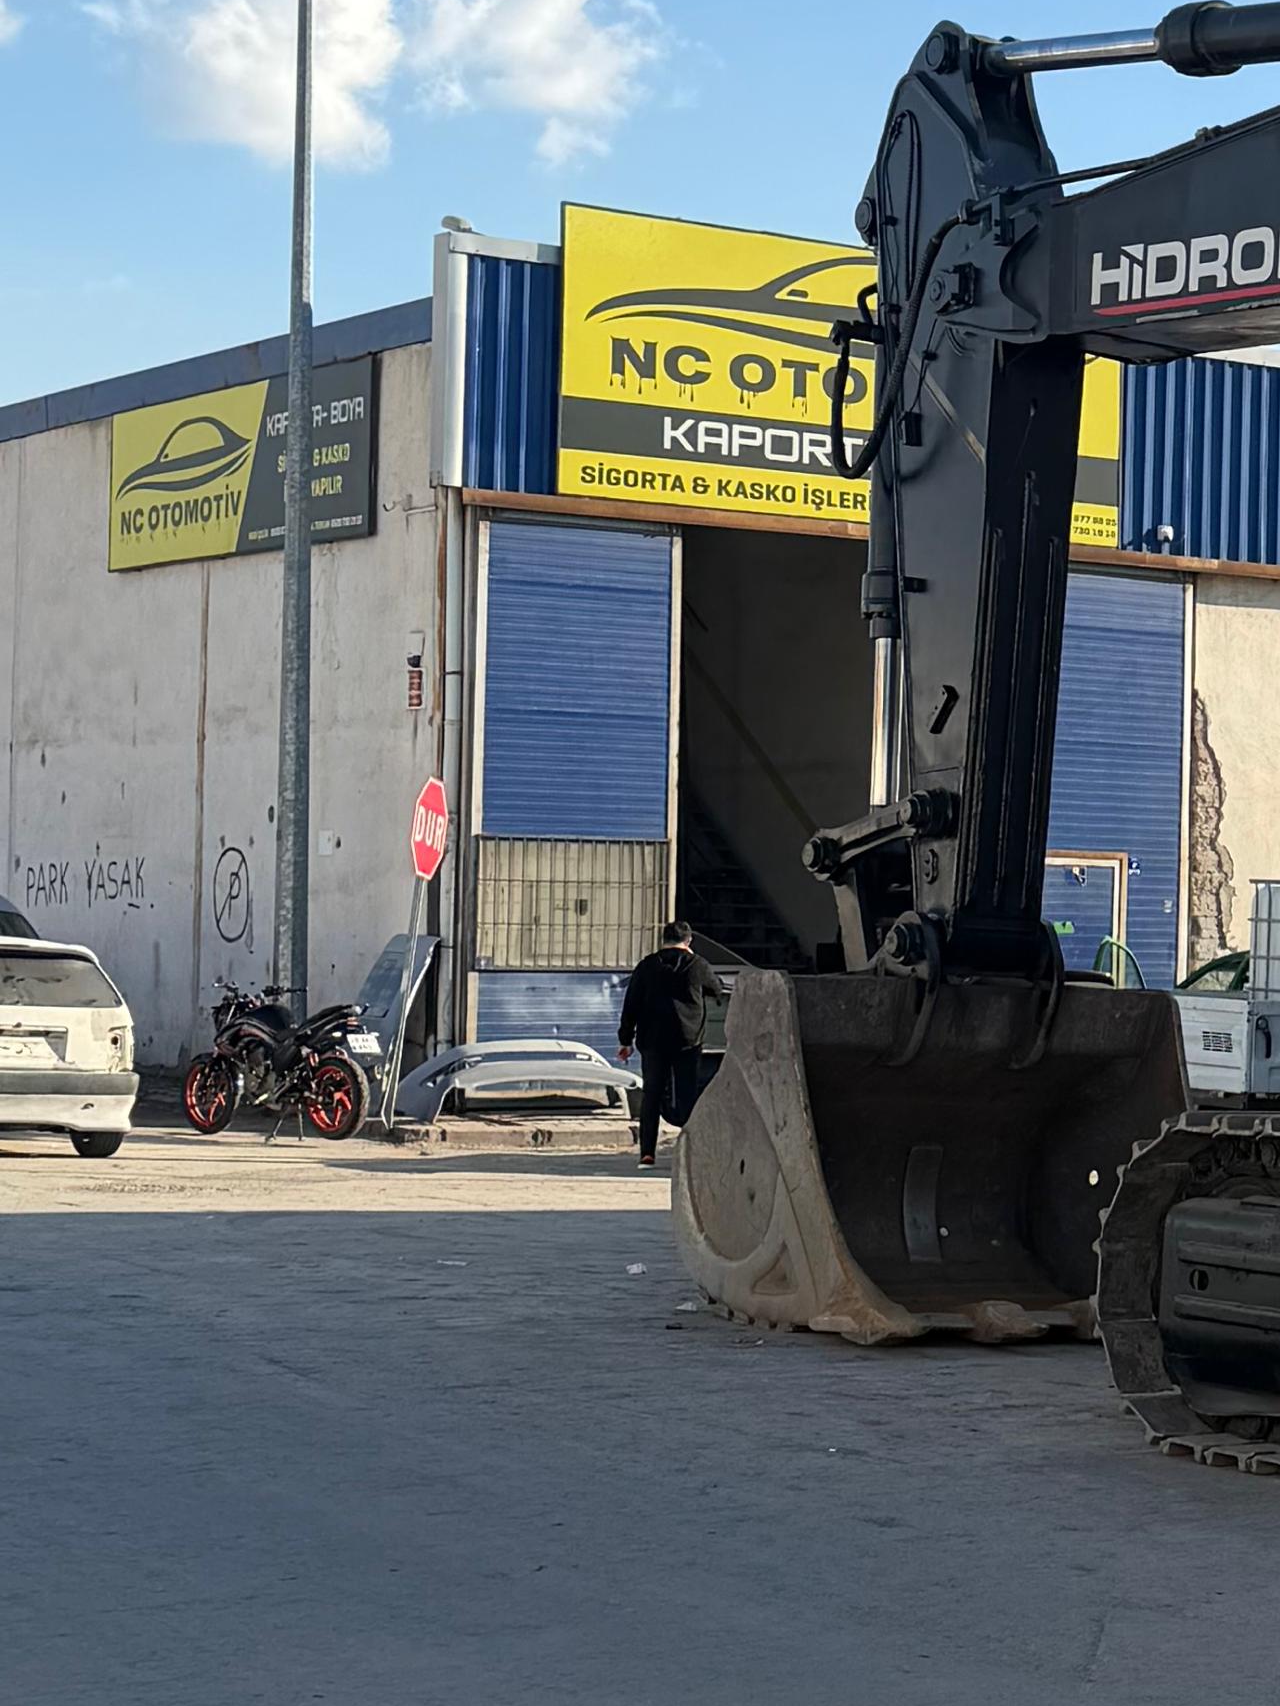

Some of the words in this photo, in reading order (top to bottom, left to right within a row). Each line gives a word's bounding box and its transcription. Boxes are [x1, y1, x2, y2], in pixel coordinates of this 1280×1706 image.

[609, 336, 712, 393] NC
[330, 396, 364, 425] BOYA
[321, 443, 350, 465] KASKO
[663, 416, 871, 469] KAPORT
[580, 462, 686, 494] SİGORTA
[692, 476, 710, 495] &
[717, 479, 796, 503] KASKO
[121, 506, 144, 537] NC
[148, 484, 242, 531] OTOMOTİV
[415, 805, 445, 852] DUR
[26, 861, 69, 908] PARK
[84, 856, 145, 908] YASAK
